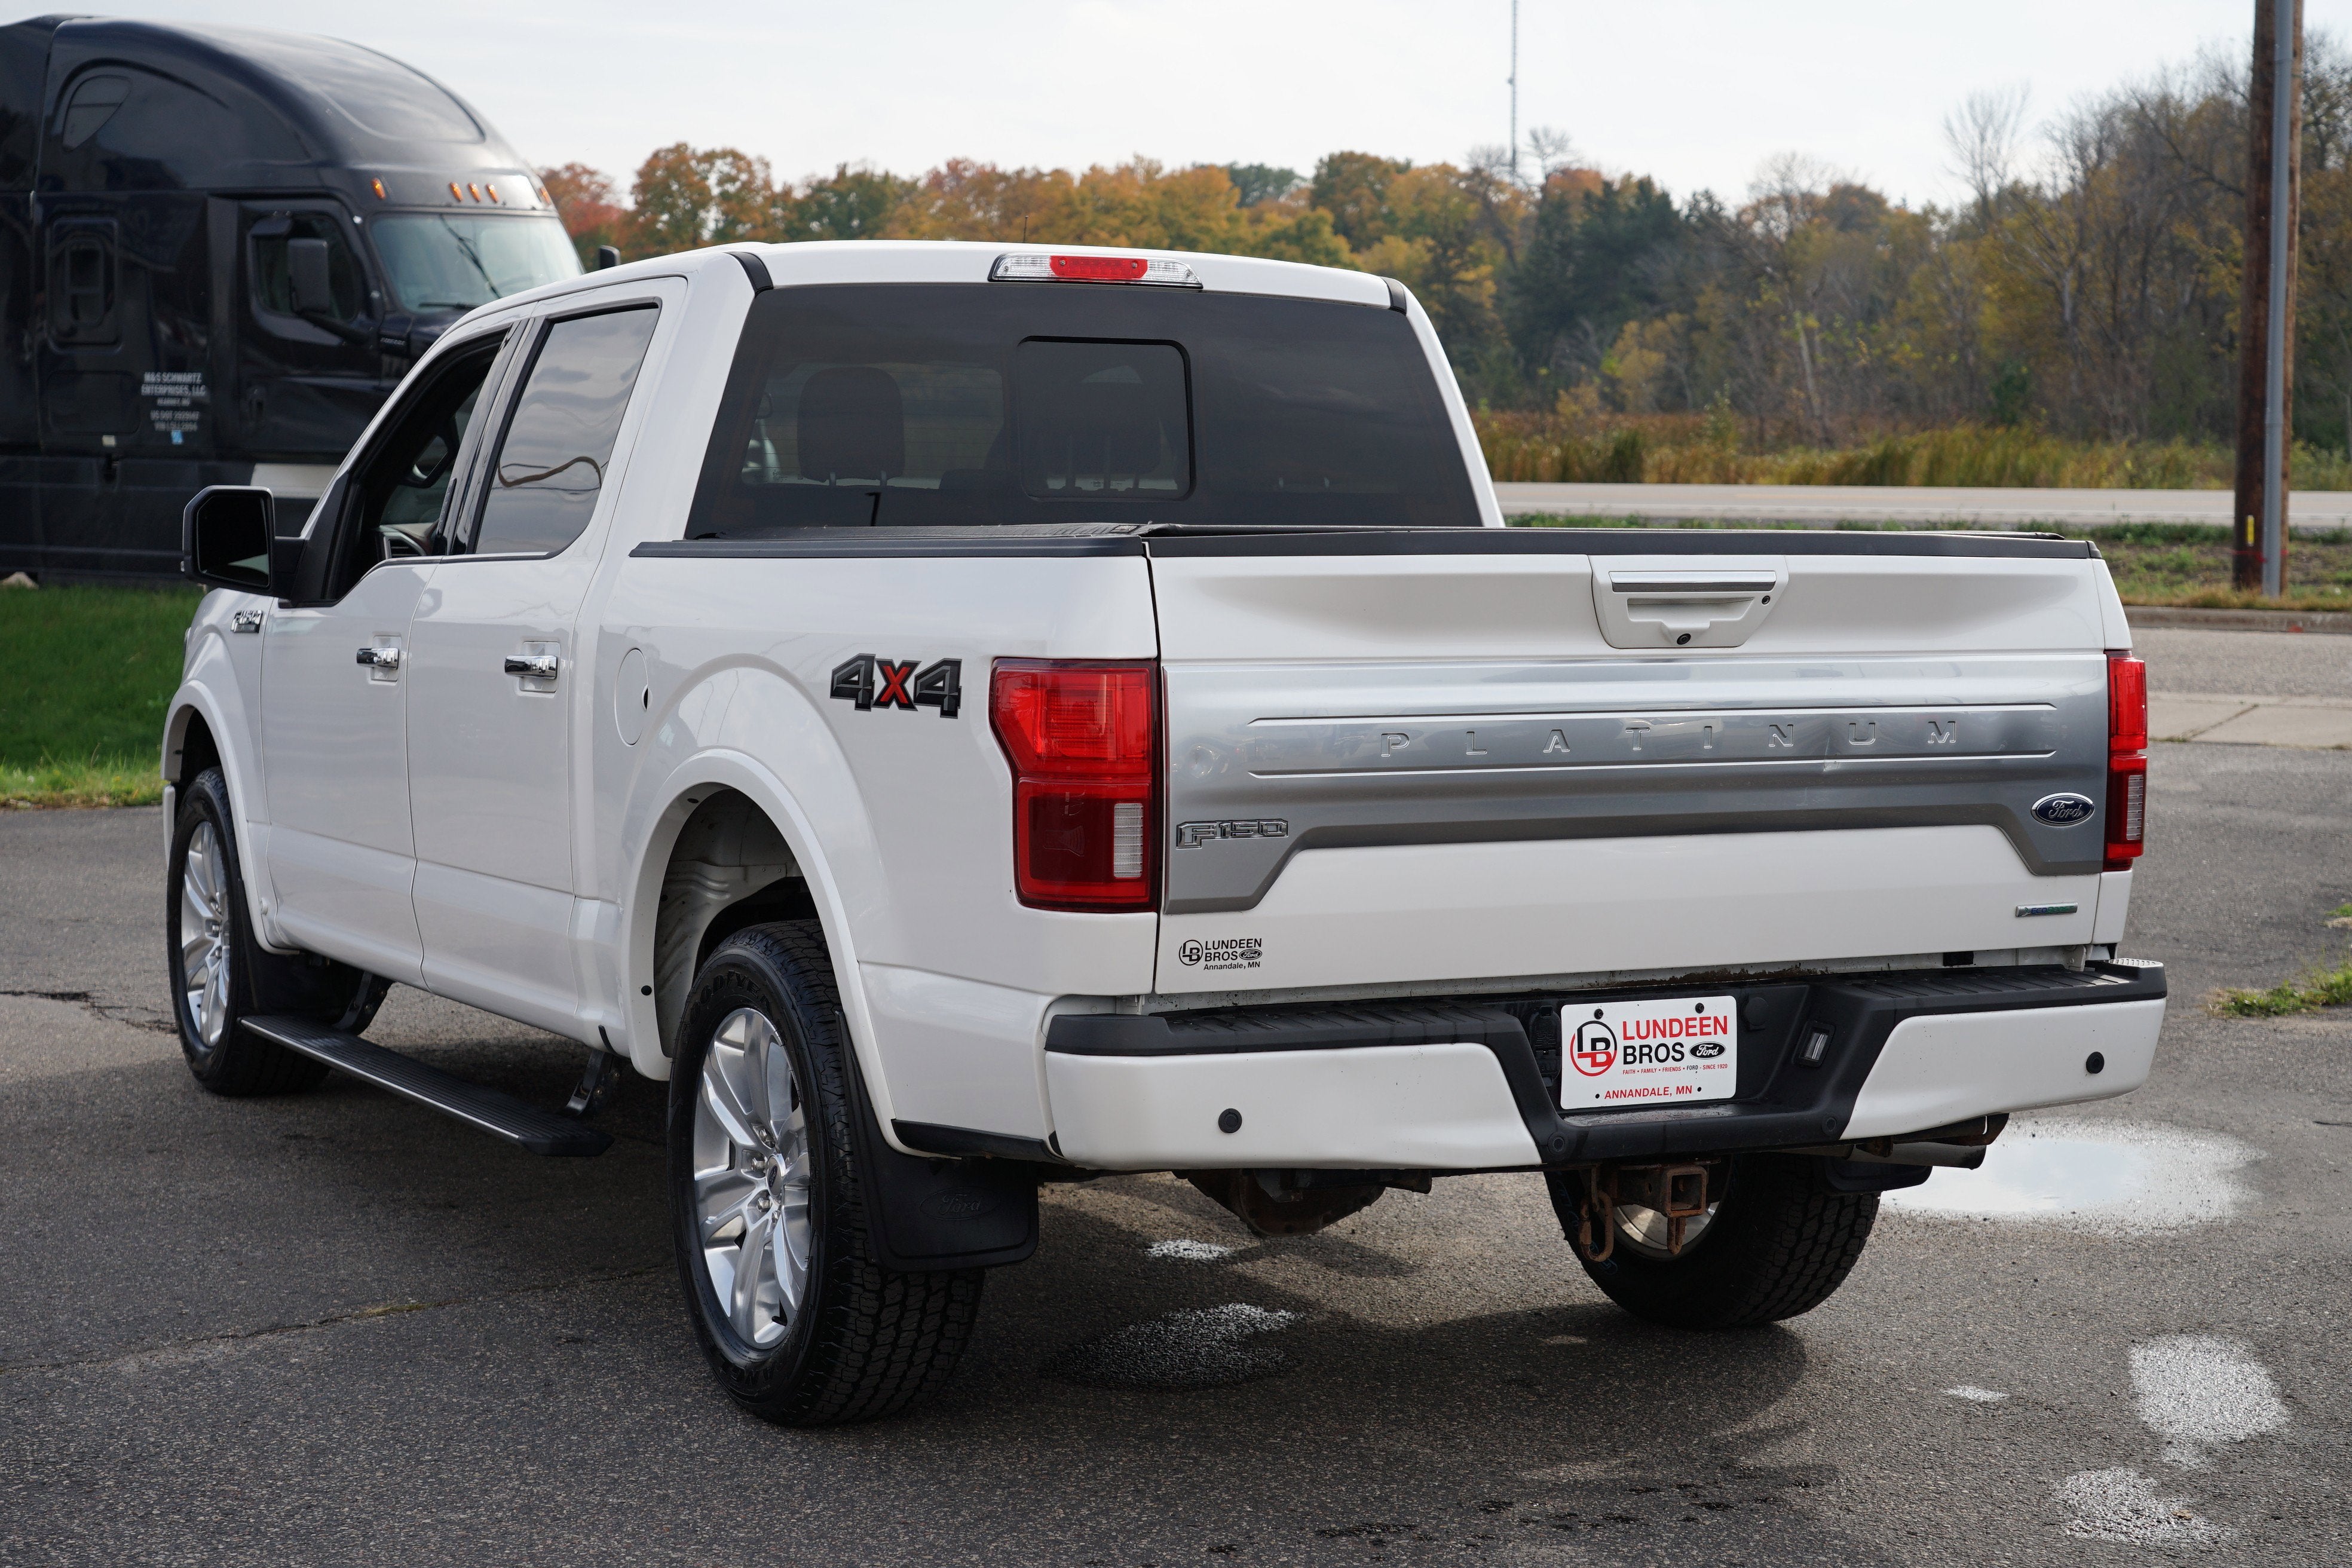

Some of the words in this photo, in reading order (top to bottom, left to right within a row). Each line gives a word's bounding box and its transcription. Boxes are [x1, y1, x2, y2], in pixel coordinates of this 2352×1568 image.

[191, 385, 206, 397] LLC
[1380, 721, 1956, 757] PLATINUM
[2047, 799, 2084, 820] Ford
[1205, 938, 1262, 950] LUNDEEN
[1205, 951, 1238, 961] BROS
[1203, 962, 1246, 970] Annandale,
[1622, 1015, 1728, 1040] LUNDEEN
[1622, 1042, 1685, 1065] BROS
[1694, 1043, 1721, 1058] Ford
[1604, 1086, 1672, 1100] ANNANDALE,
[1676, 1085, 1692, 1095] MN
[938, 1194, 981, 1215] Ford
